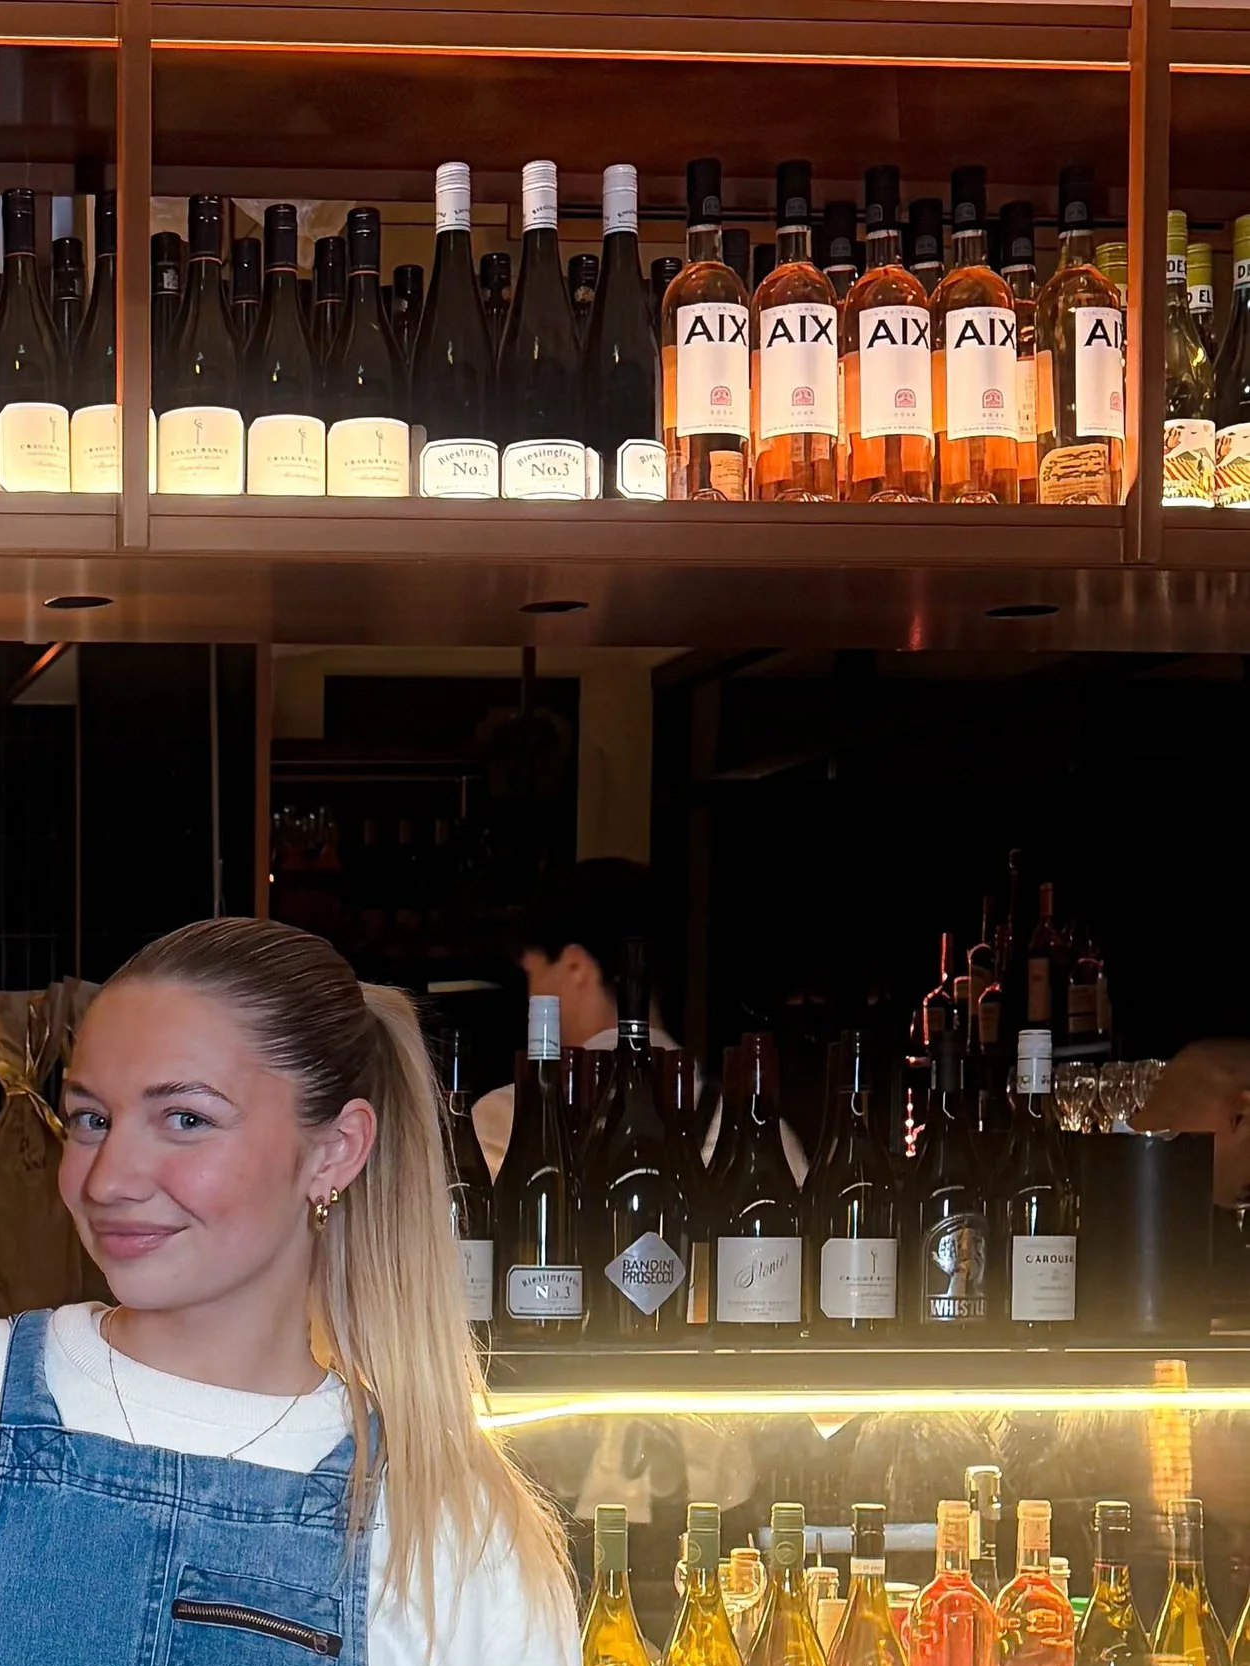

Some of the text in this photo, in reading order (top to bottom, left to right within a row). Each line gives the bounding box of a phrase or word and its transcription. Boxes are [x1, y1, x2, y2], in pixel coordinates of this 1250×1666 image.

[684, 314, 747, 347] AIX
[766, 315, 834, 348] AIX
[866, 318, 930, 349] AIX
[954, 318, 1016, 349] AIX
[1084, 318, 1123, 347] AI
[531, 462, 570, 477] No.3
[622, 1259, 674, 1271] BANDINI
[622, 1271, 674, 1284] PROSECCO
